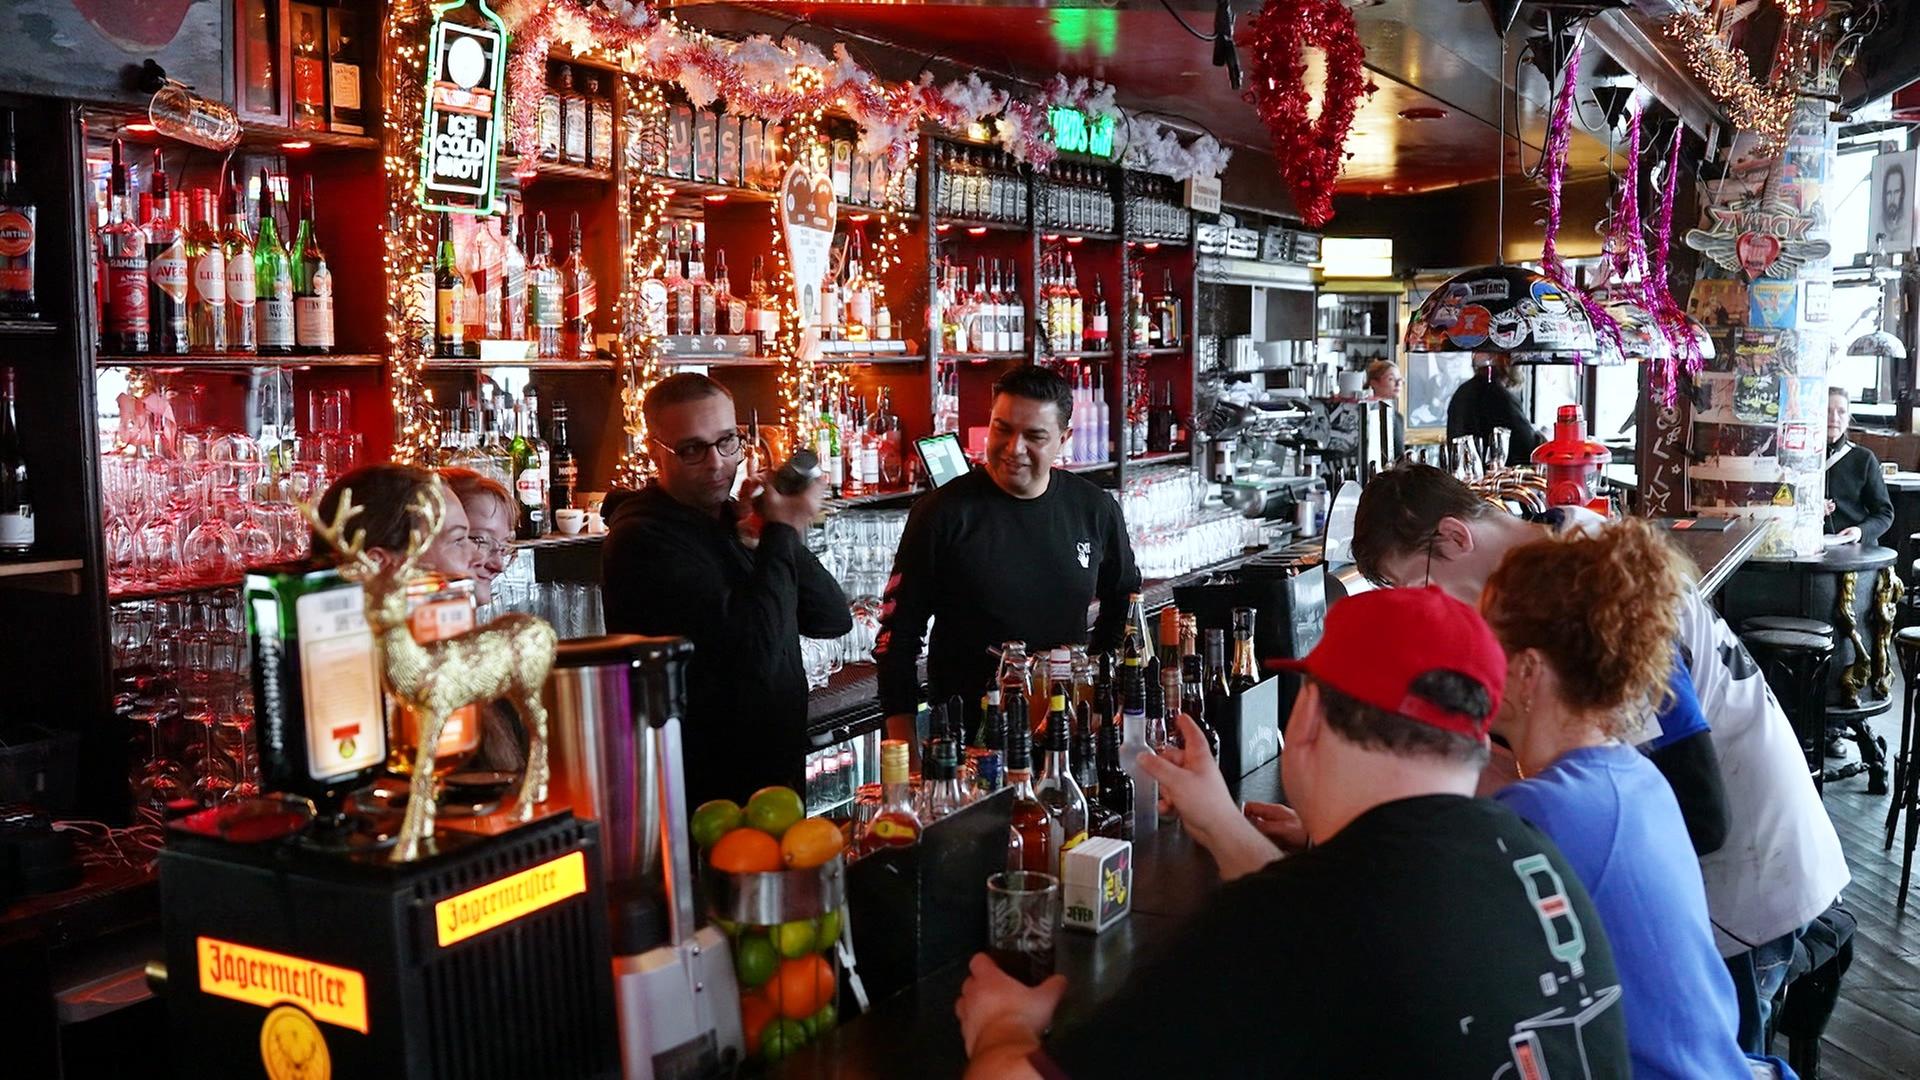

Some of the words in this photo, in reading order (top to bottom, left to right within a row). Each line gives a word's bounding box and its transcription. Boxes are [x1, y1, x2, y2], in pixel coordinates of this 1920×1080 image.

[447, 114, 478, 138] ICE
[436, 133, 485, 160] COLD
[436, 154, 483, 180] SHOT
[0, 230, 30, 238] ARTINI
[1066, 905, 1094, 922] JEVER
